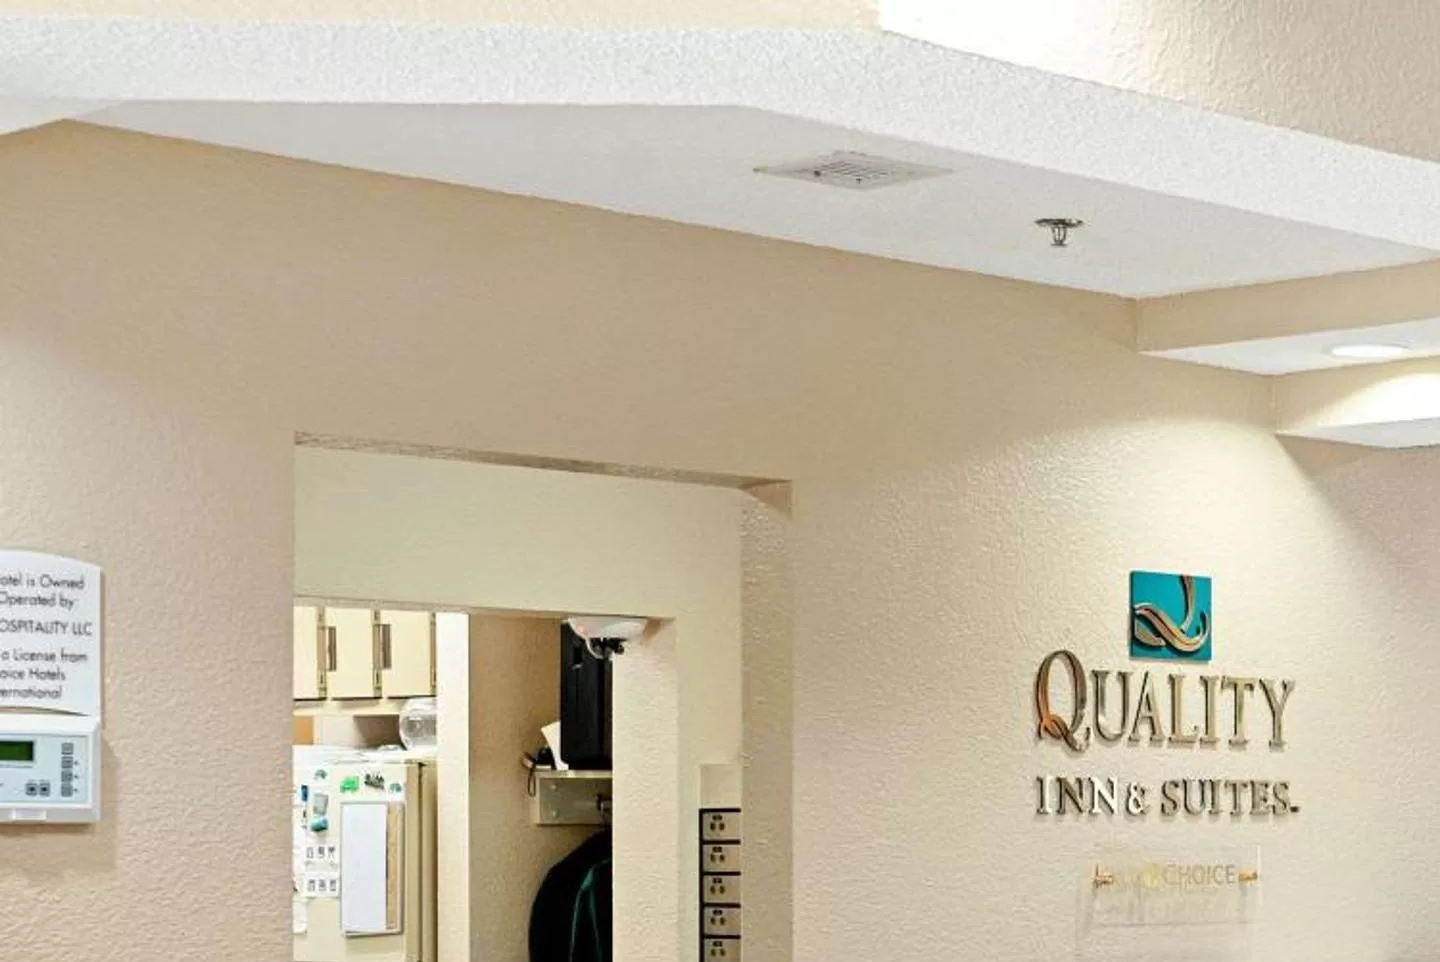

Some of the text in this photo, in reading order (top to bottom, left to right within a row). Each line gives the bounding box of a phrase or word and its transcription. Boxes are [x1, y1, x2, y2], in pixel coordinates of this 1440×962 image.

[0, 573, 85, 590] otel is Owned
[59, 592, 75, 611] by
[0, 619, 93, 636] OSPITALITY LLC
[13, 648, 57, 662] License
[60, 647, 88, 663] from
[0, 665, 66, 681] oice Hotels
[1035, 650, 1296, 751] QUALITY
[1036, 776, 1119, 816] INN
[1162, 864, 1237, 886] CHOICE
